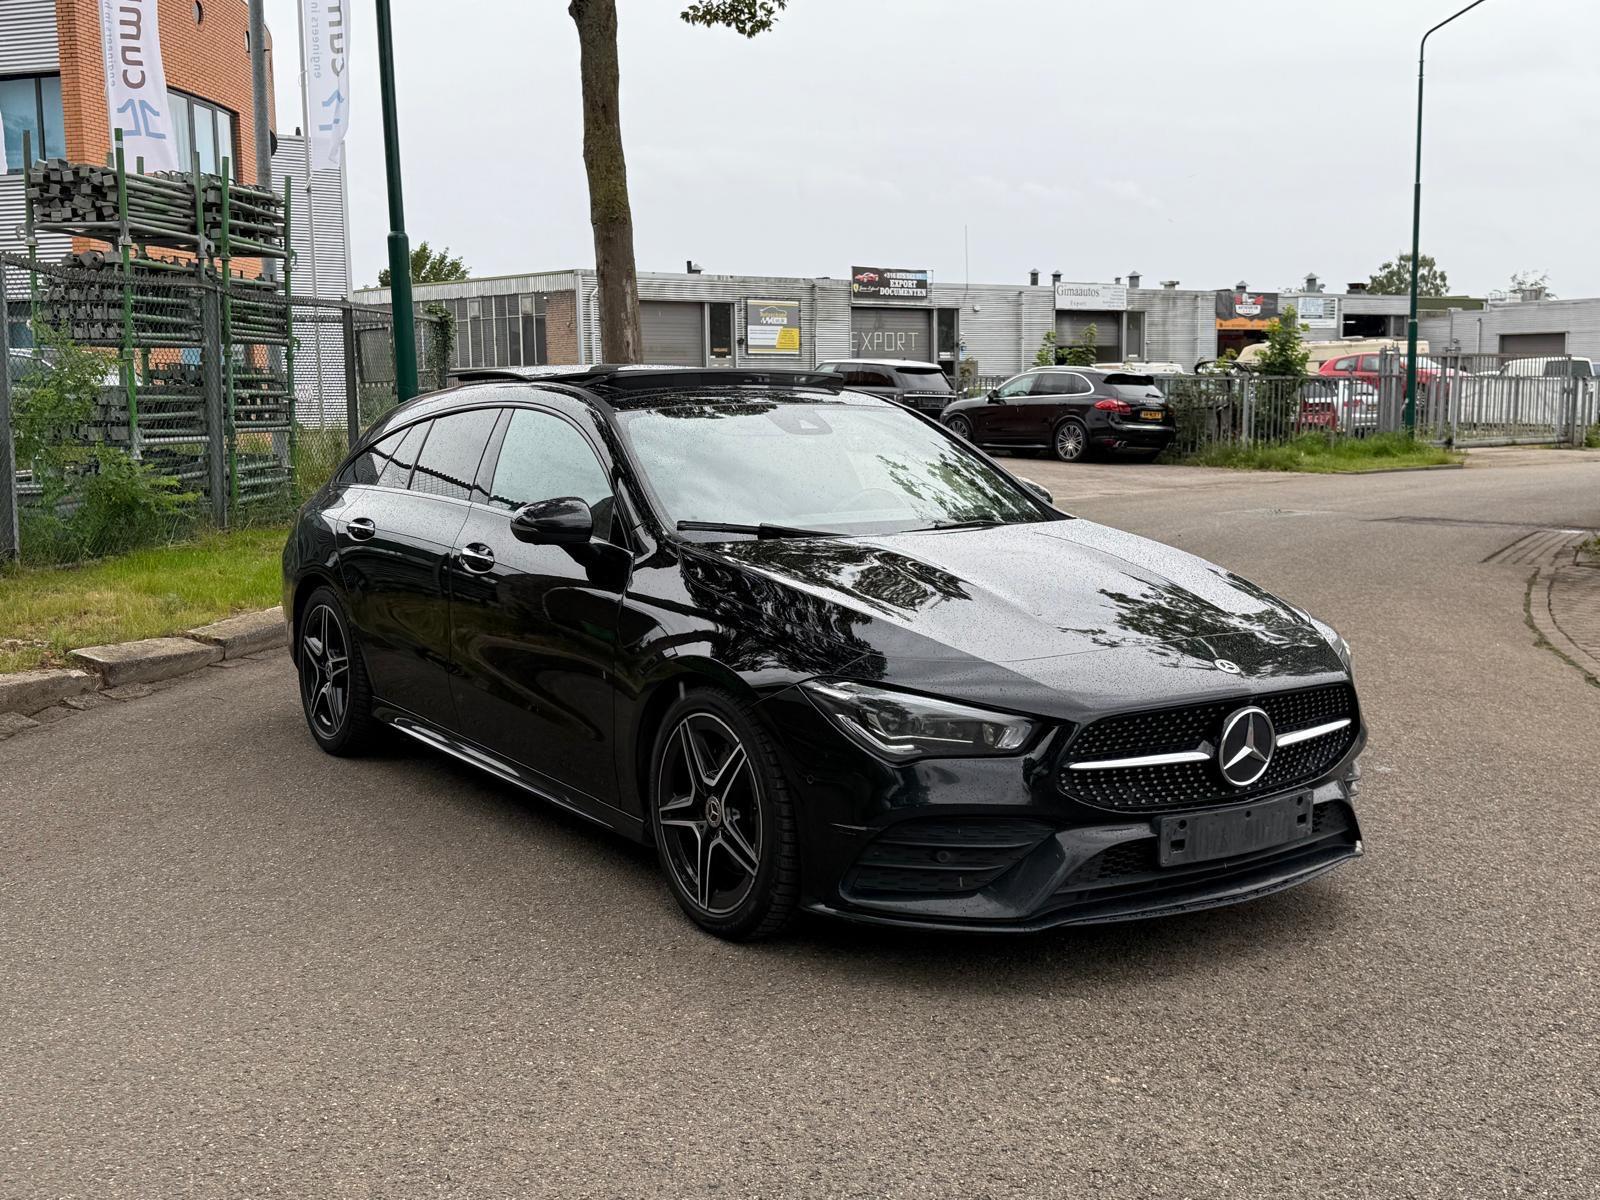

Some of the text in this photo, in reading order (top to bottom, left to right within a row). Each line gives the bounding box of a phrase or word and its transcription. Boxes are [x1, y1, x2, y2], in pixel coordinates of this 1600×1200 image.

[889, 279, 918, 288] EXPORT
[879, 287, 927, 297] DOCUMENTEN
[851, 331, 919, 351] EXPORT
